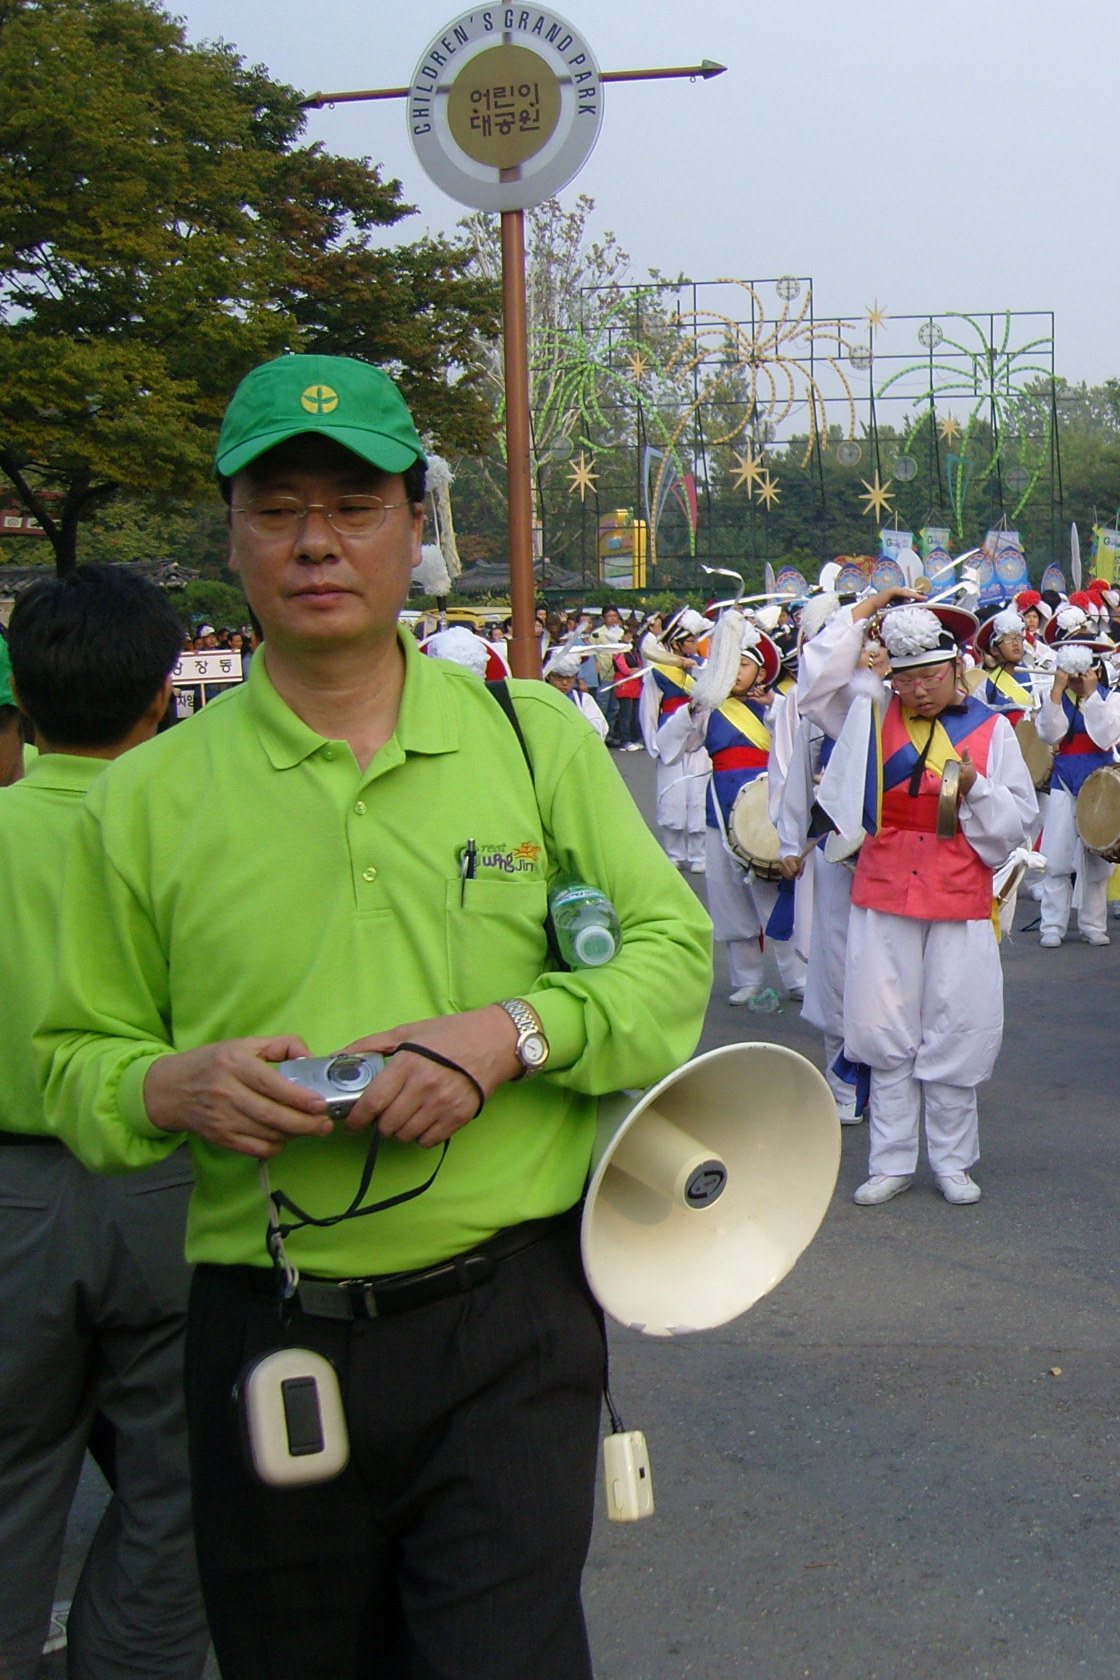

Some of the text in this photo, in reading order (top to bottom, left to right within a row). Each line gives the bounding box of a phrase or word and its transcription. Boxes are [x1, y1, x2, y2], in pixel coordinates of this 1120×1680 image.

[412, 9, 596, 136] CHILDREN'S GRAND PARK
[470, 82, 540, 111] 어린이
[470, 108, 540, 137] 대공원
